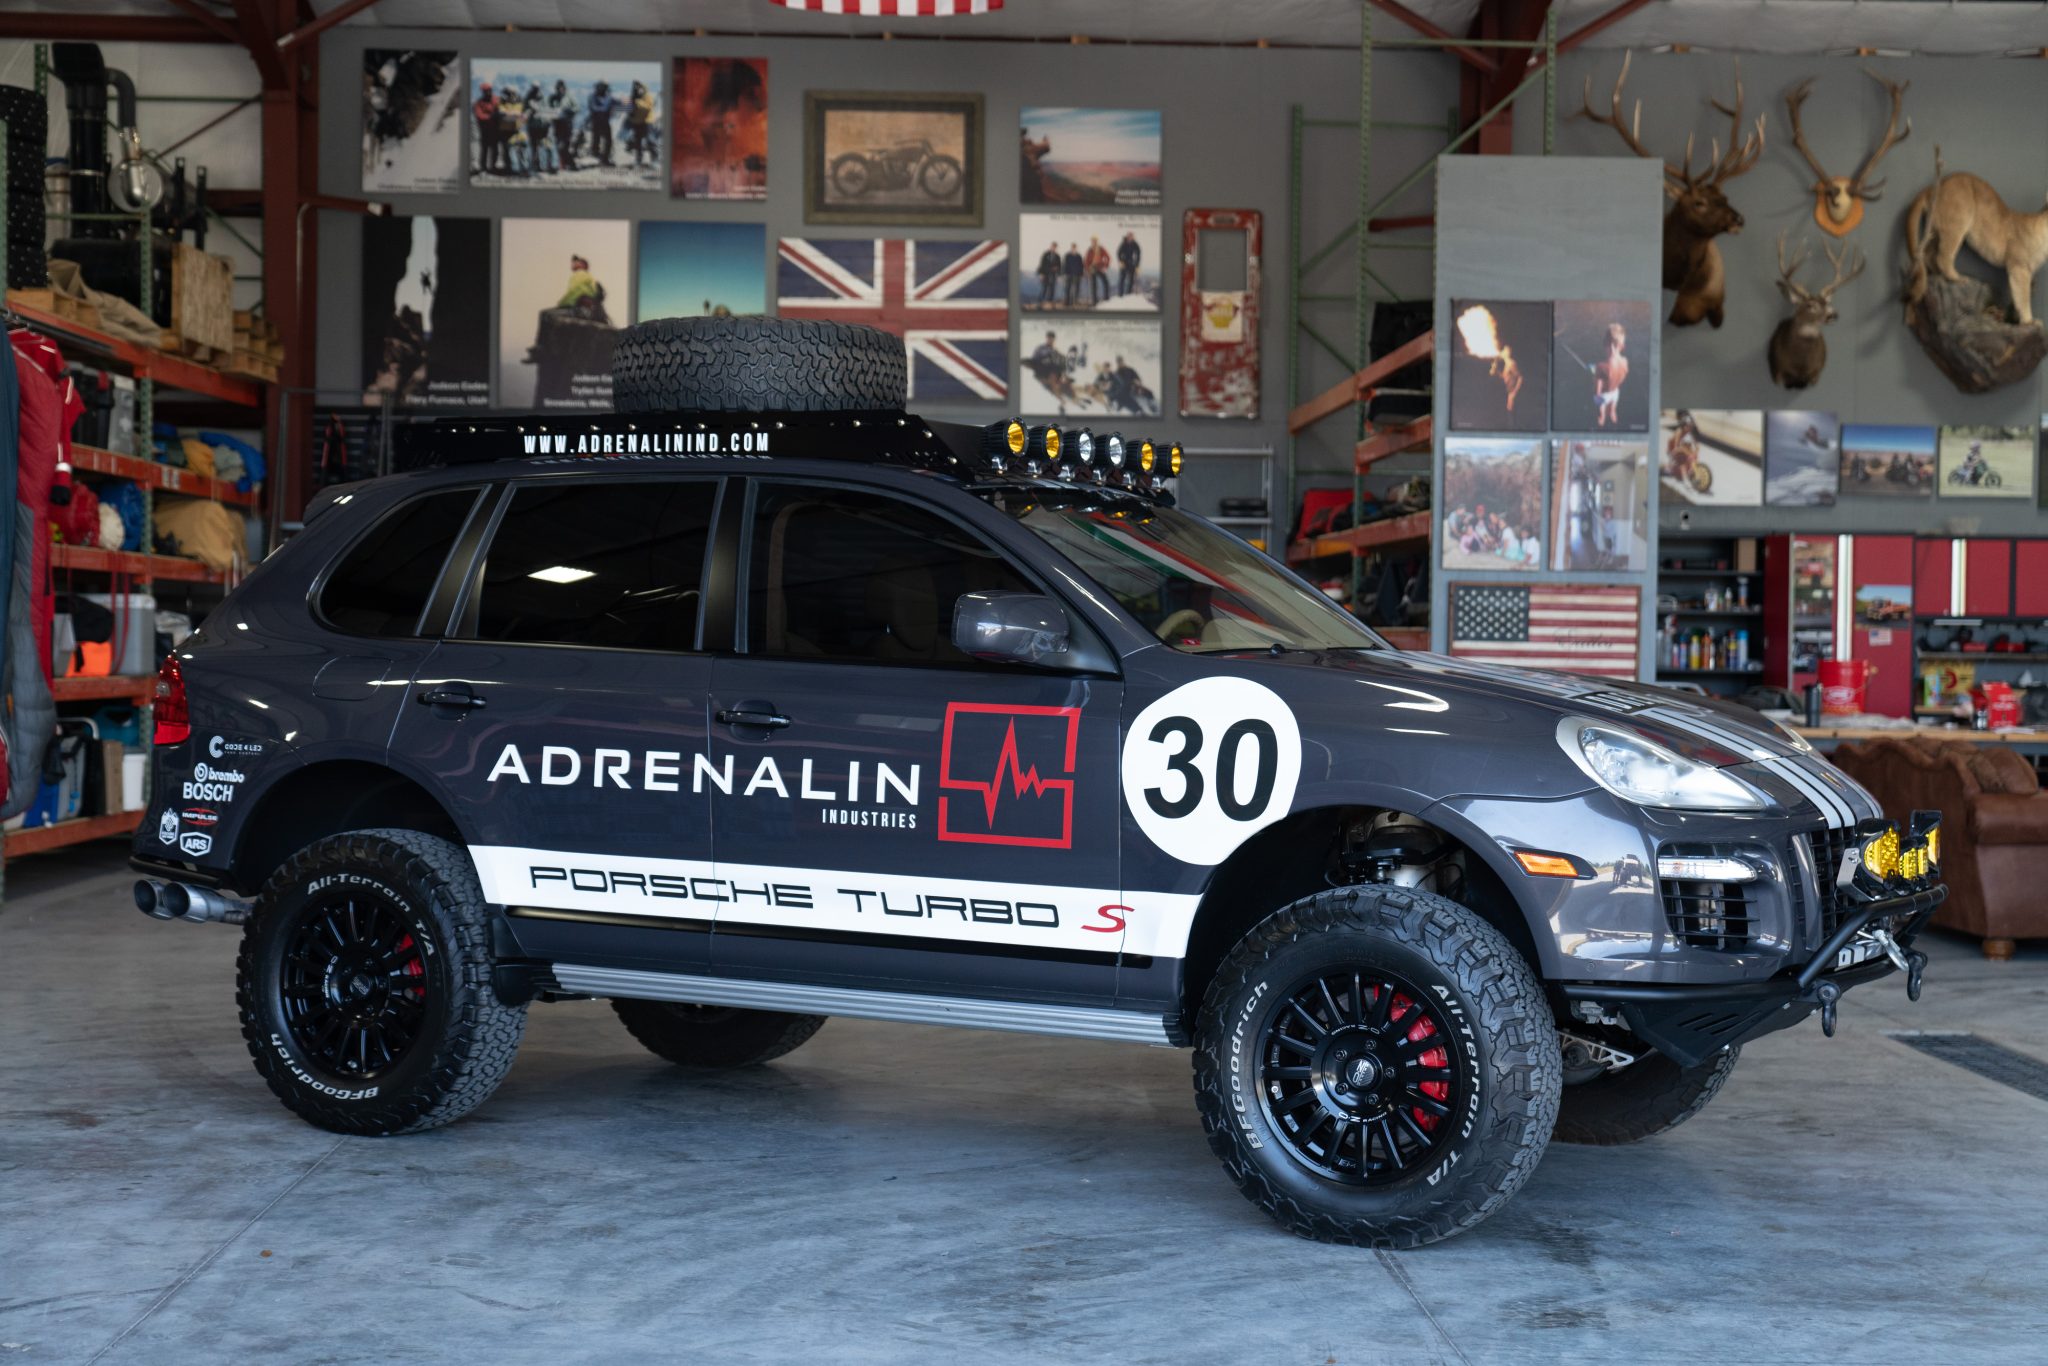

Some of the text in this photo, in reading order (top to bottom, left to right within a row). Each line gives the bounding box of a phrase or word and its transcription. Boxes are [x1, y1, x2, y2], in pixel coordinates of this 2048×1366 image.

[523, 432, 769, 454] WWW.ADRENALININD.COM
[182, 781, 234, 802] BOSCH
[208, 767, 245, 783] brembo
[486, 743, 921, 806] ADRENALIN
[1143, 715, 1278, 822] 30
[182, 811, 218, 822] IMPULSE
[185, 838, 208, 850] ARS
[822, 808, 916, 829] INDUSTRIES
[307, 873, 435, 957] All-Terrain T/A
[529, 866, 1133, 933] PORSCHE TURBO S
[270, 1033, 379, 1101] BFGoodrich
[1228, 981, 1268, 1150] BFGoodrich
[1426, 984, 1480, 1187] All-Terrain T/A
